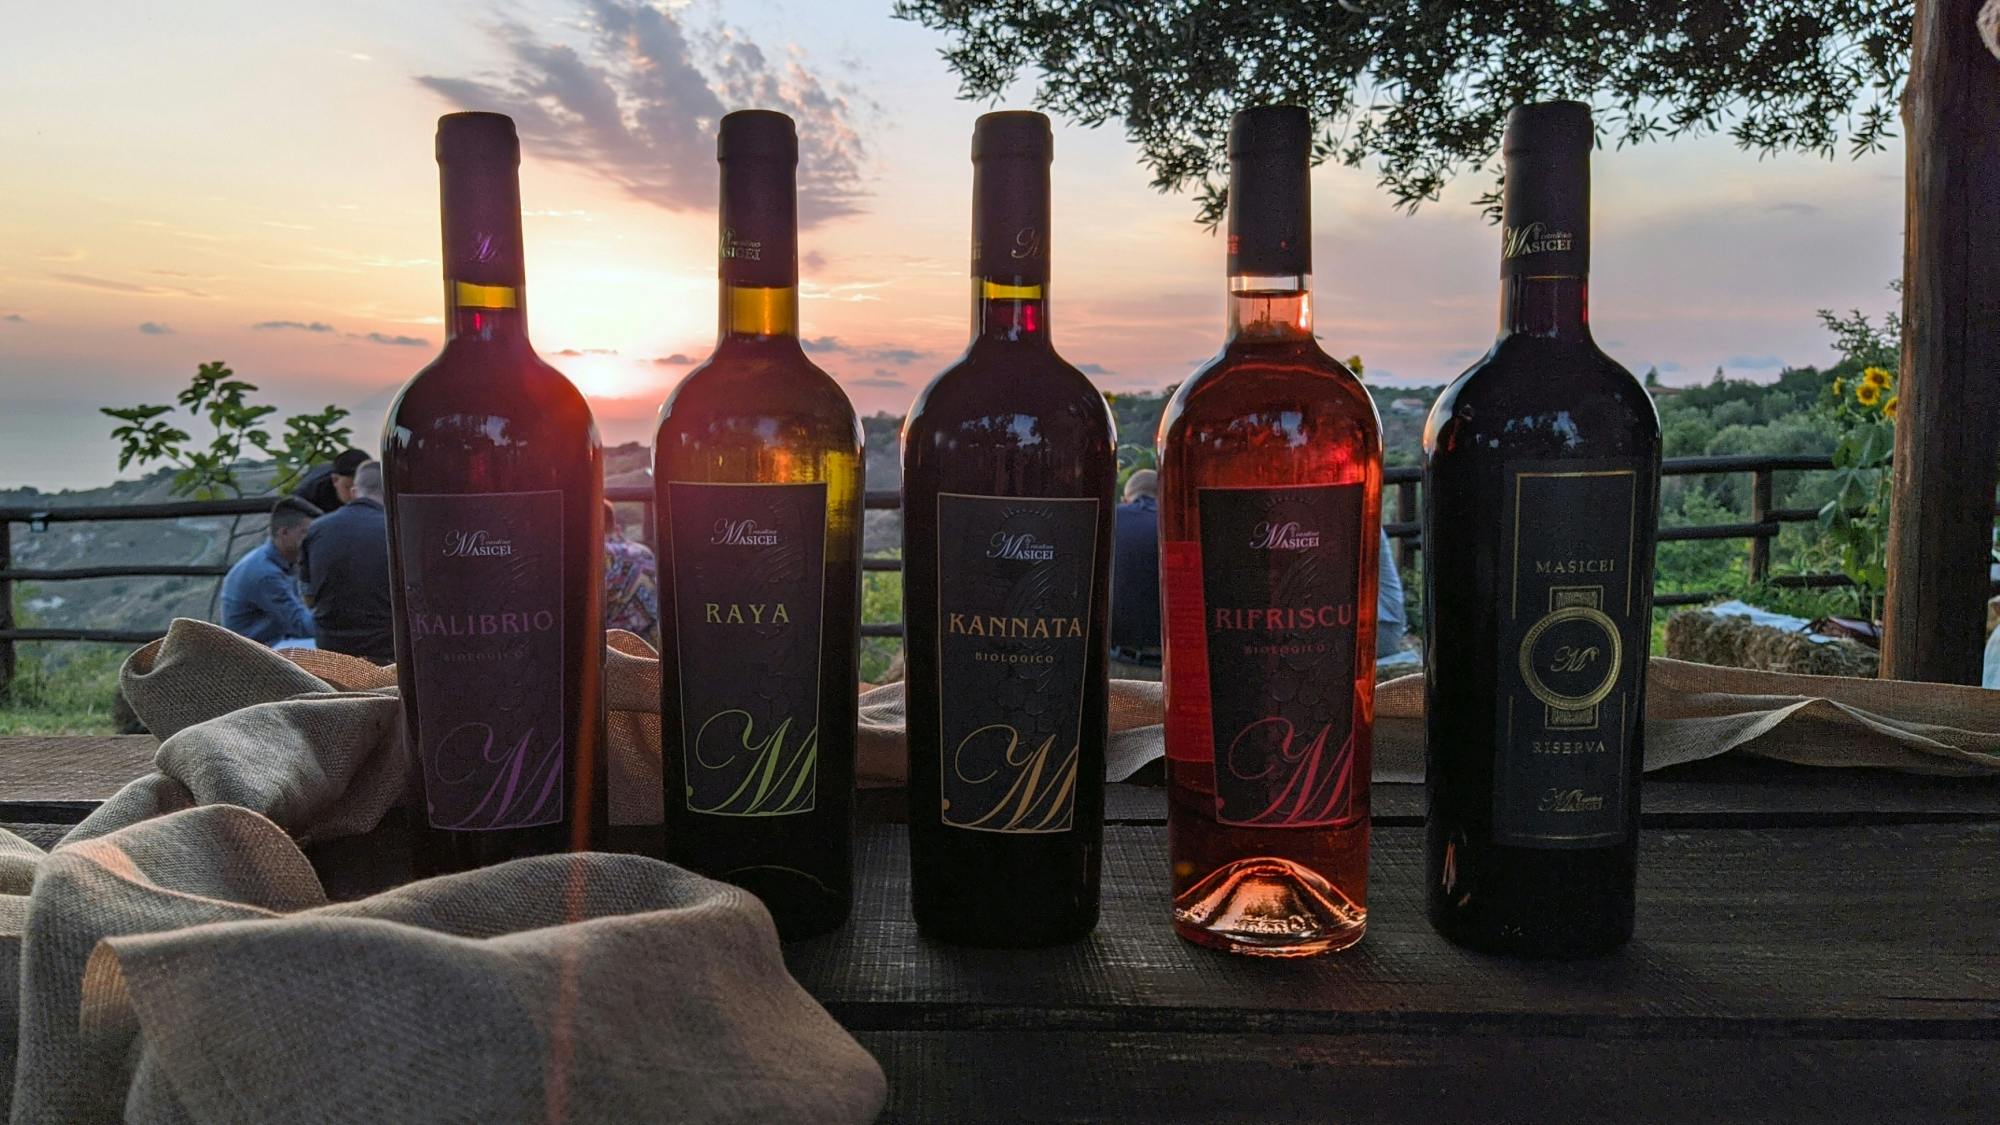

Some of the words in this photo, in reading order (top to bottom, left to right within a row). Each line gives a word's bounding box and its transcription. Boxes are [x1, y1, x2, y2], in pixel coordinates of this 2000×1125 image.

[1502, 221, 1574, 260] MASICEI
[442, 529, 512, 558] MASICEI
[710, 517, 778, 545] MASICEI
[1248, 521, 1320, 550] MASICEI
[986, 531, 1054, 560] MASICEI
[1535, 559, 1616, 575] MASICEI
[414, 609, 553, 635] KALIBRIO
[704, 602, 791, 624] RAYA
[948, 612, 1083, 639] KANNATA
[1214, 603, 1353, 631] RIFRISCU
[974, 651, 1055, 664] BIOLOGICO
[1243, 643, 1327, 656] BIOLOGICO
[1532, 740, 1607, 755] RISERVA
